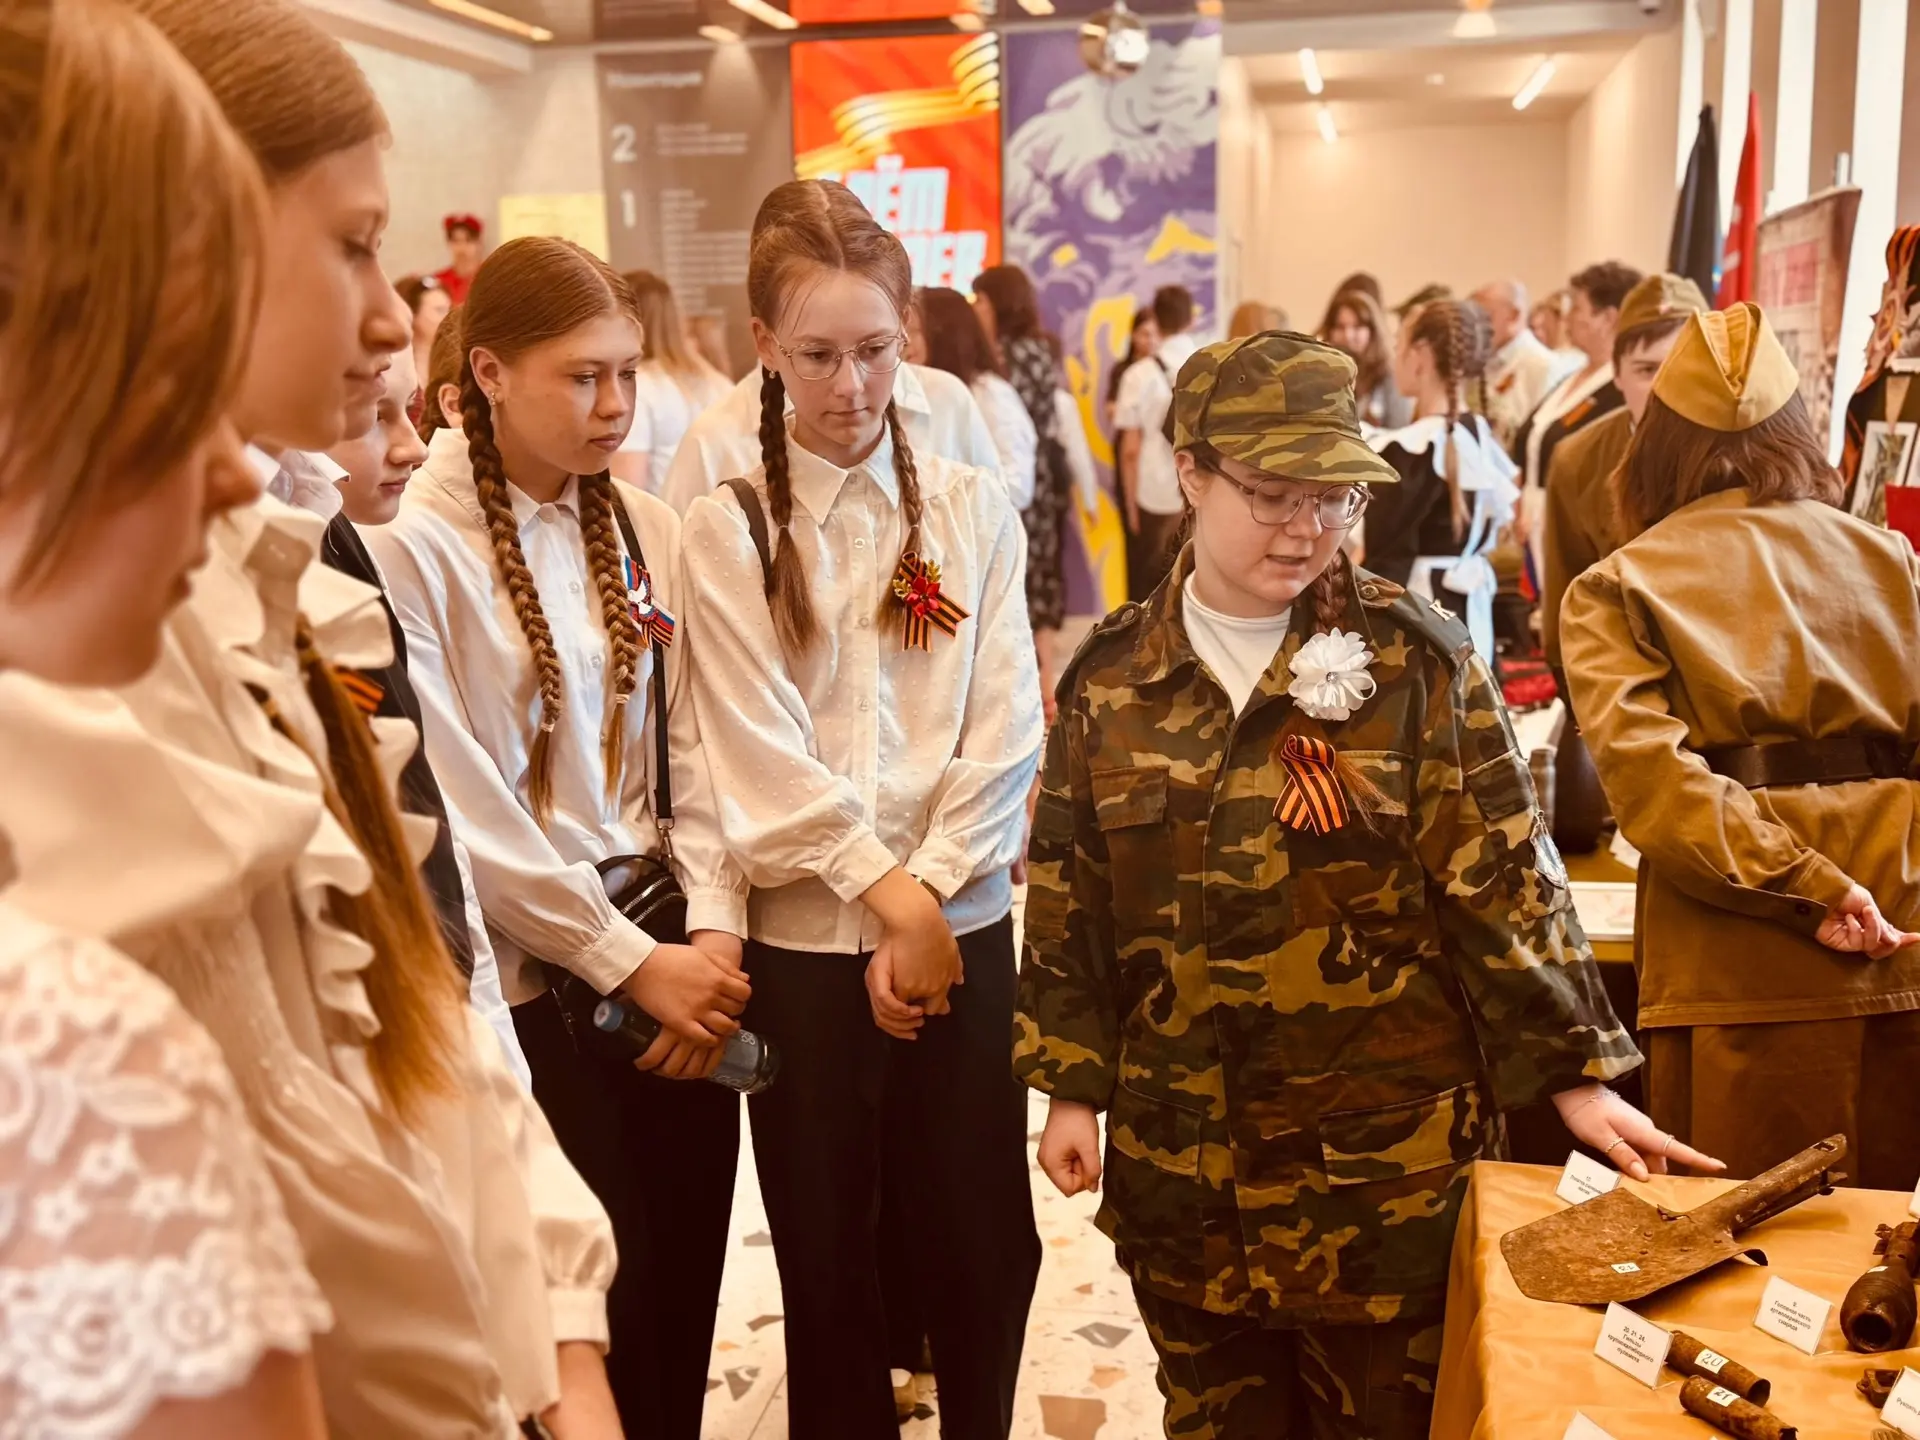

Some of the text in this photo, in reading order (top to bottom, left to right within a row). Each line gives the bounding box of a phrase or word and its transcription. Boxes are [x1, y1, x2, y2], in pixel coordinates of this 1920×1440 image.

[611, 125, 636, 162] 2
[620, 189, 635, 229] 1
[1796, 1312, 1812, 1323] часть
[1622, 1333, 1642, 1348] Гильзы
[1700, 1353, 1724, 1368] 20
